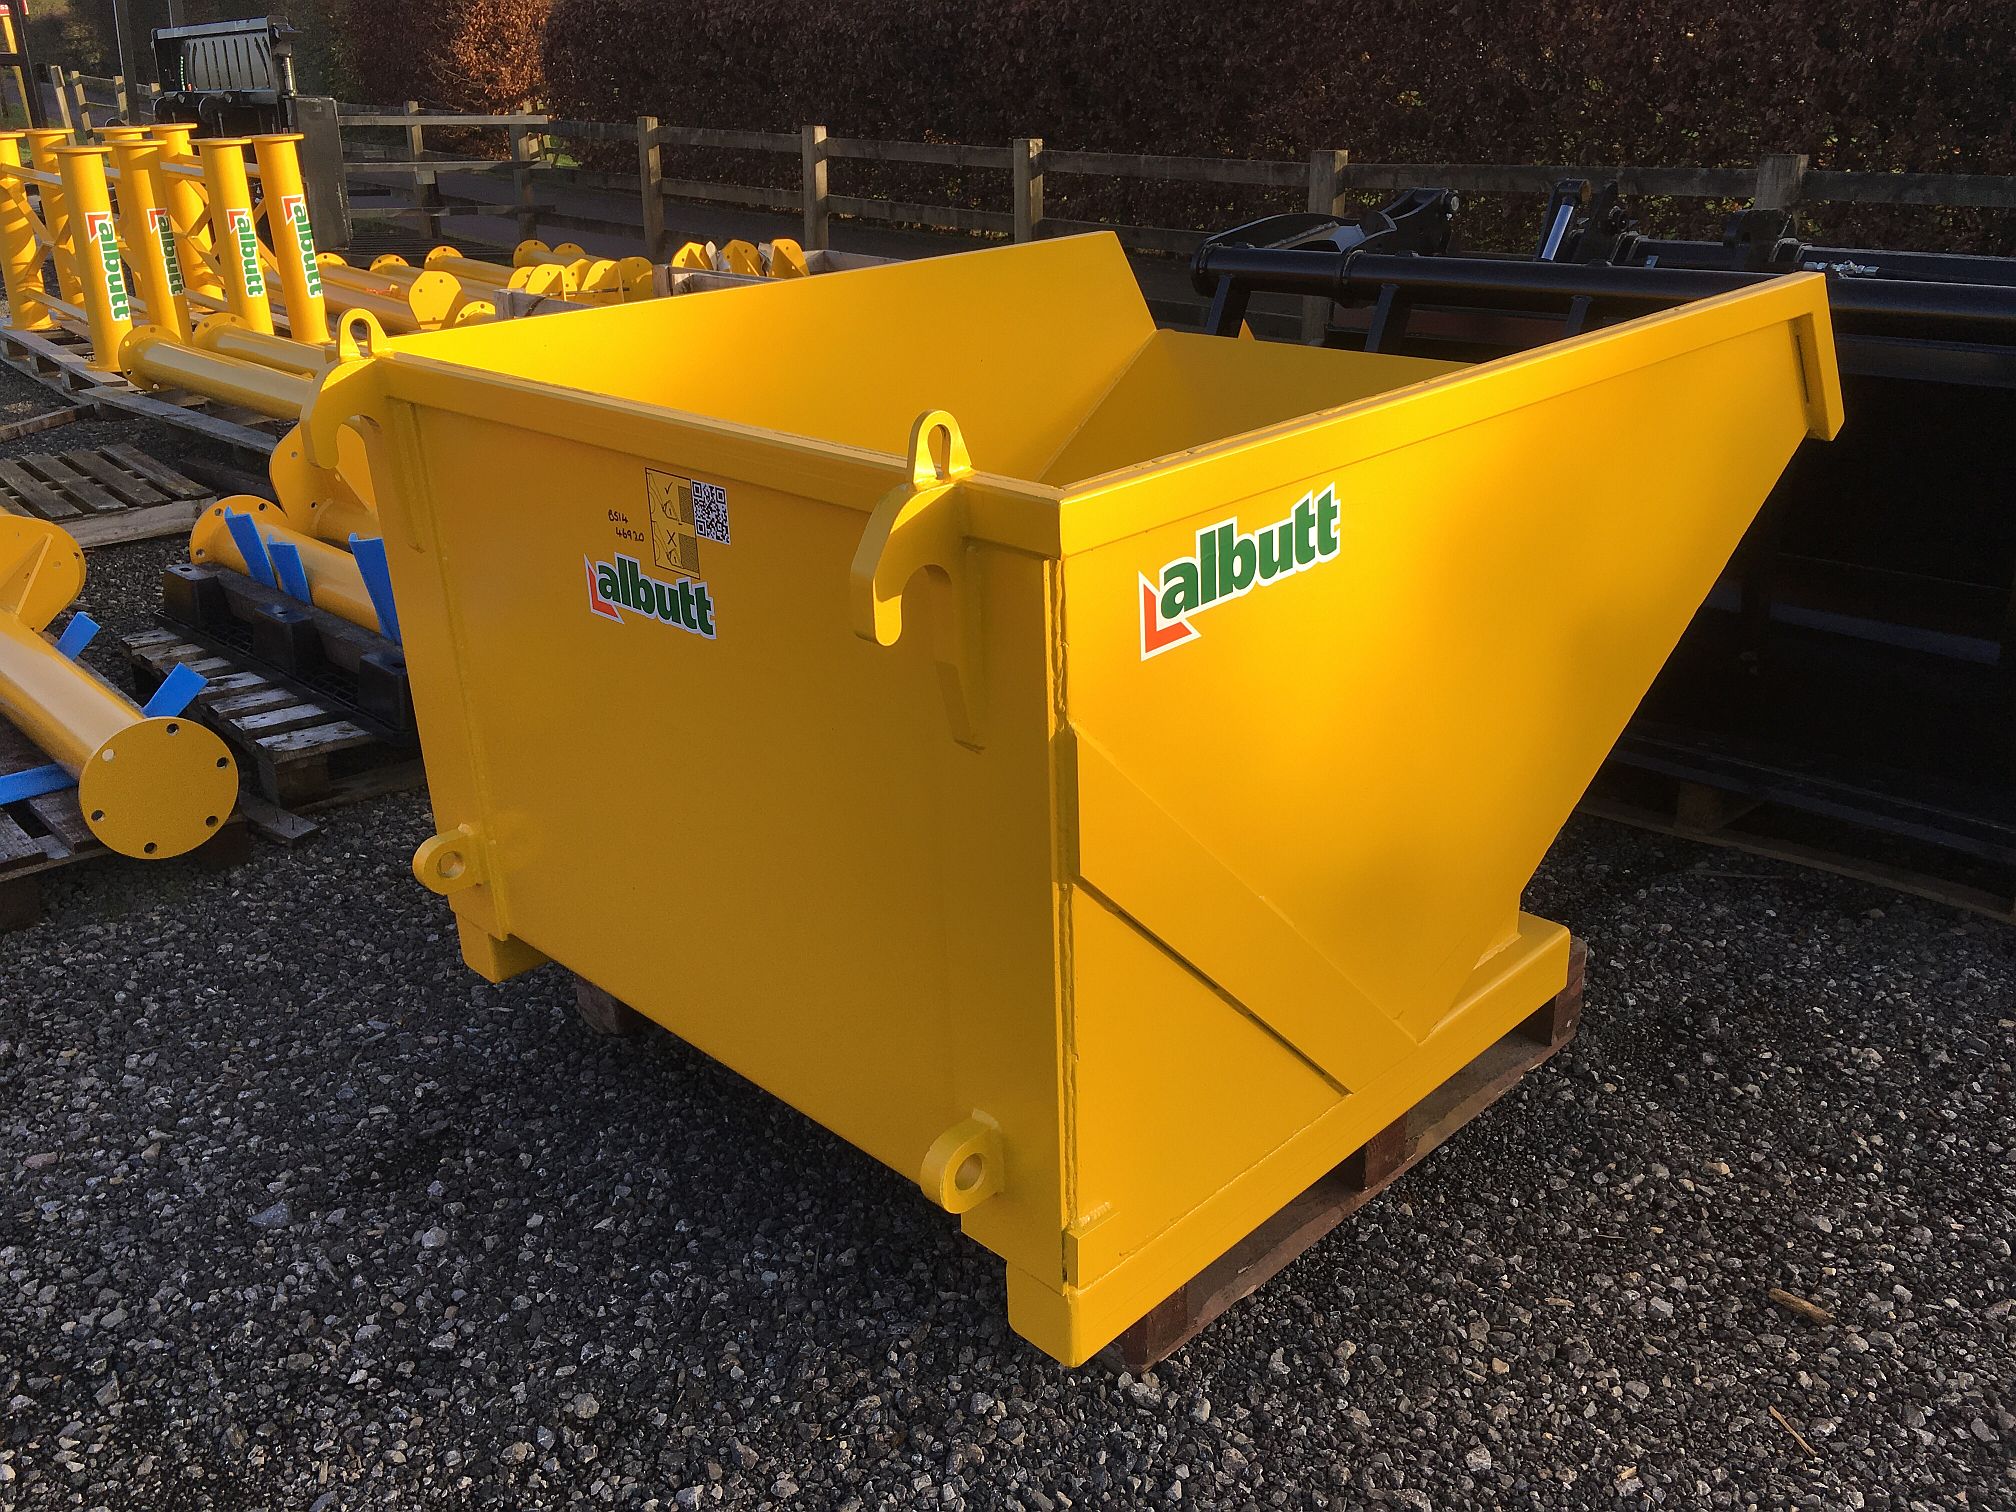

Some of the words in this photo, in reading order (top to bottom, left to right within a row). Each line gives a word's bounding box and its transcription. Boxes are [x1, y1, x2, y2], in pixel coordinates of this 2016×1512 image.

[98, 221, 129, 319] albutt
[157, 216, 184, 295] albutt
[237, 217, 264, 296] albutt
[294, 204, 322, 296] albutt
[598, 556, 713, 635] albutt
[1160, 489, 1338, 619] albutt
